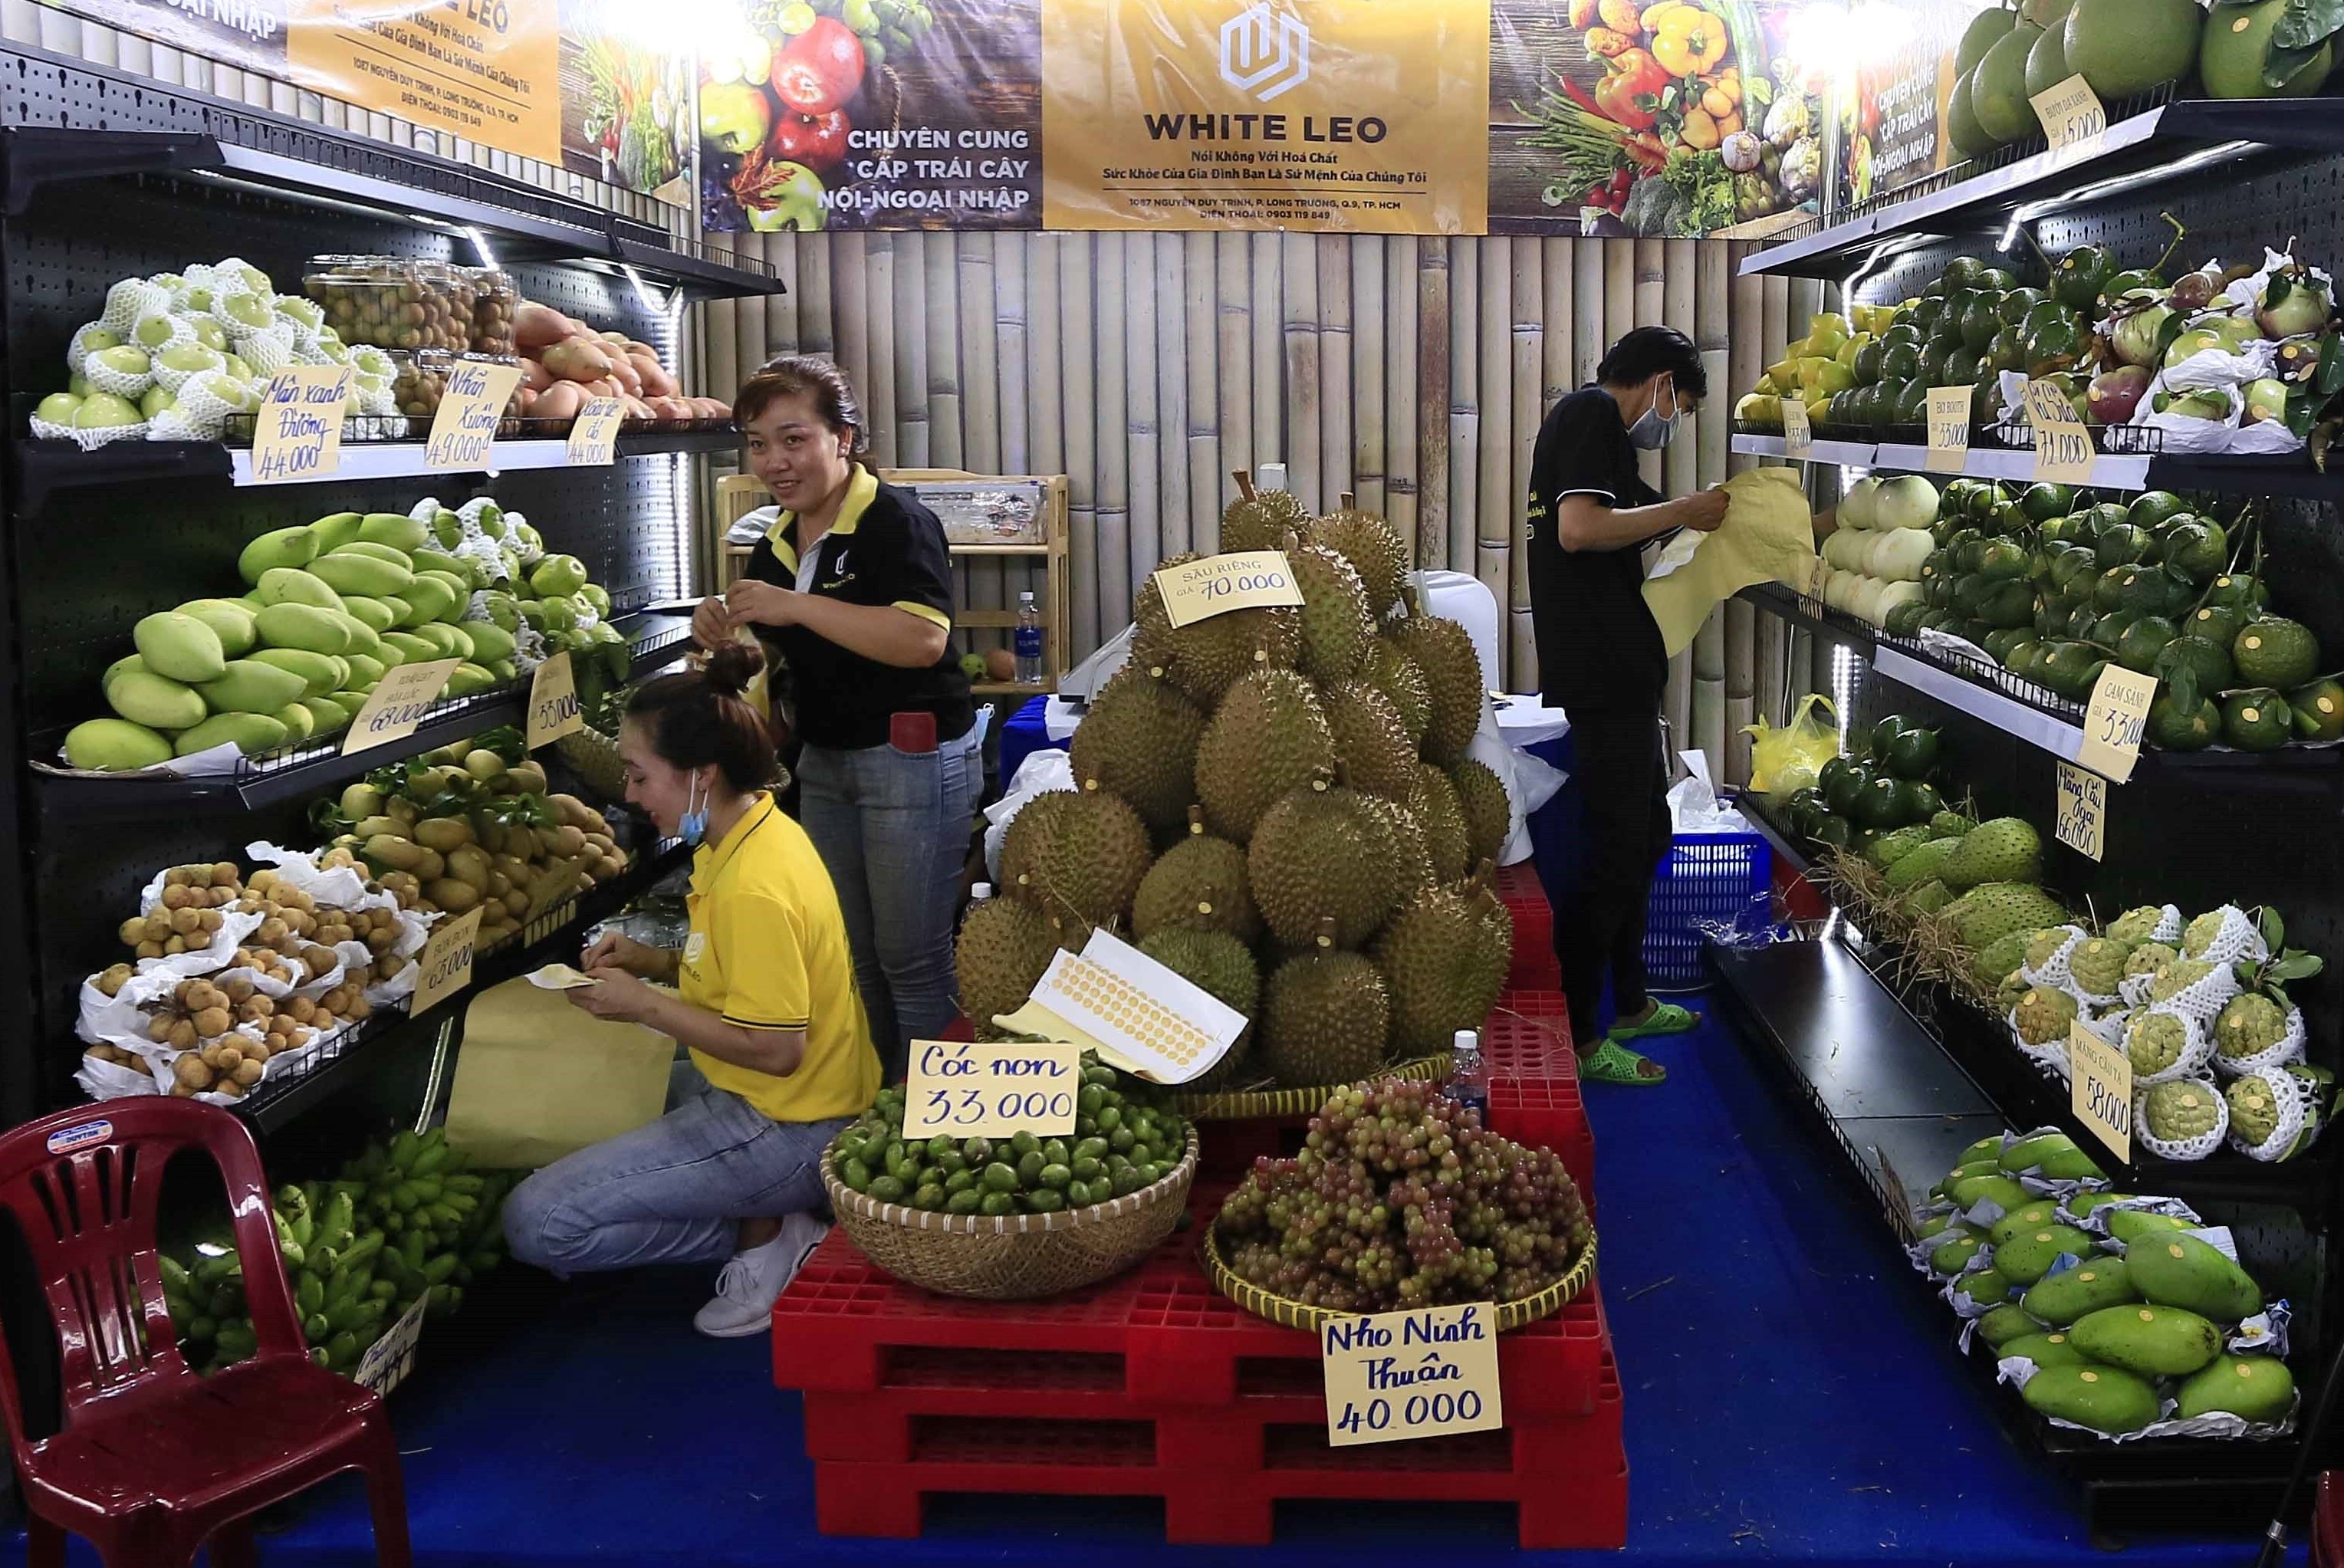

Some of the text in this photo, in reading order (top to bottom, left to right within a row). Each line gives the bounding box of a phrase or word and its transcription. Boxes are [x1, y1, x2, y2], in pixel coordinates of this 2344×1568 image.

[847, 126, 1029, 149] CHUYÊN CUNG
[1143, 113, 1387, 143] WHITE LEO
[856, 155, 1030, 179] CẤP TRÁI CÂY
[1192, 150, 1212, 163] Nói
[1215, 150, 1254, 164] Không
[1188, 167, 1208, 179] Gia
[1210, 168, 1240, 179] Đình
[1242, 168, 1265, 182] Bạn
[1268, 168, 1282, 179] Là
[817, 186, 1030, 212] NỘI-NGOẠI NHẬP
[1129, 199, 1152, 207] 1087
[1198, 199, 1218, 207] DUY
[1267, 199, 1292, 207] LONG
[1379, 201, 1401, 210] HCM
[1266, 211, 1292, 219] 0903
[1294, 211, 1309, 219] 119
[1217, 559, 1262, 574] RIÊNG
[920, 1044, 1070, 1078] Cóc non
[1327, 1306, 1486, 1356] Nho Ninh
